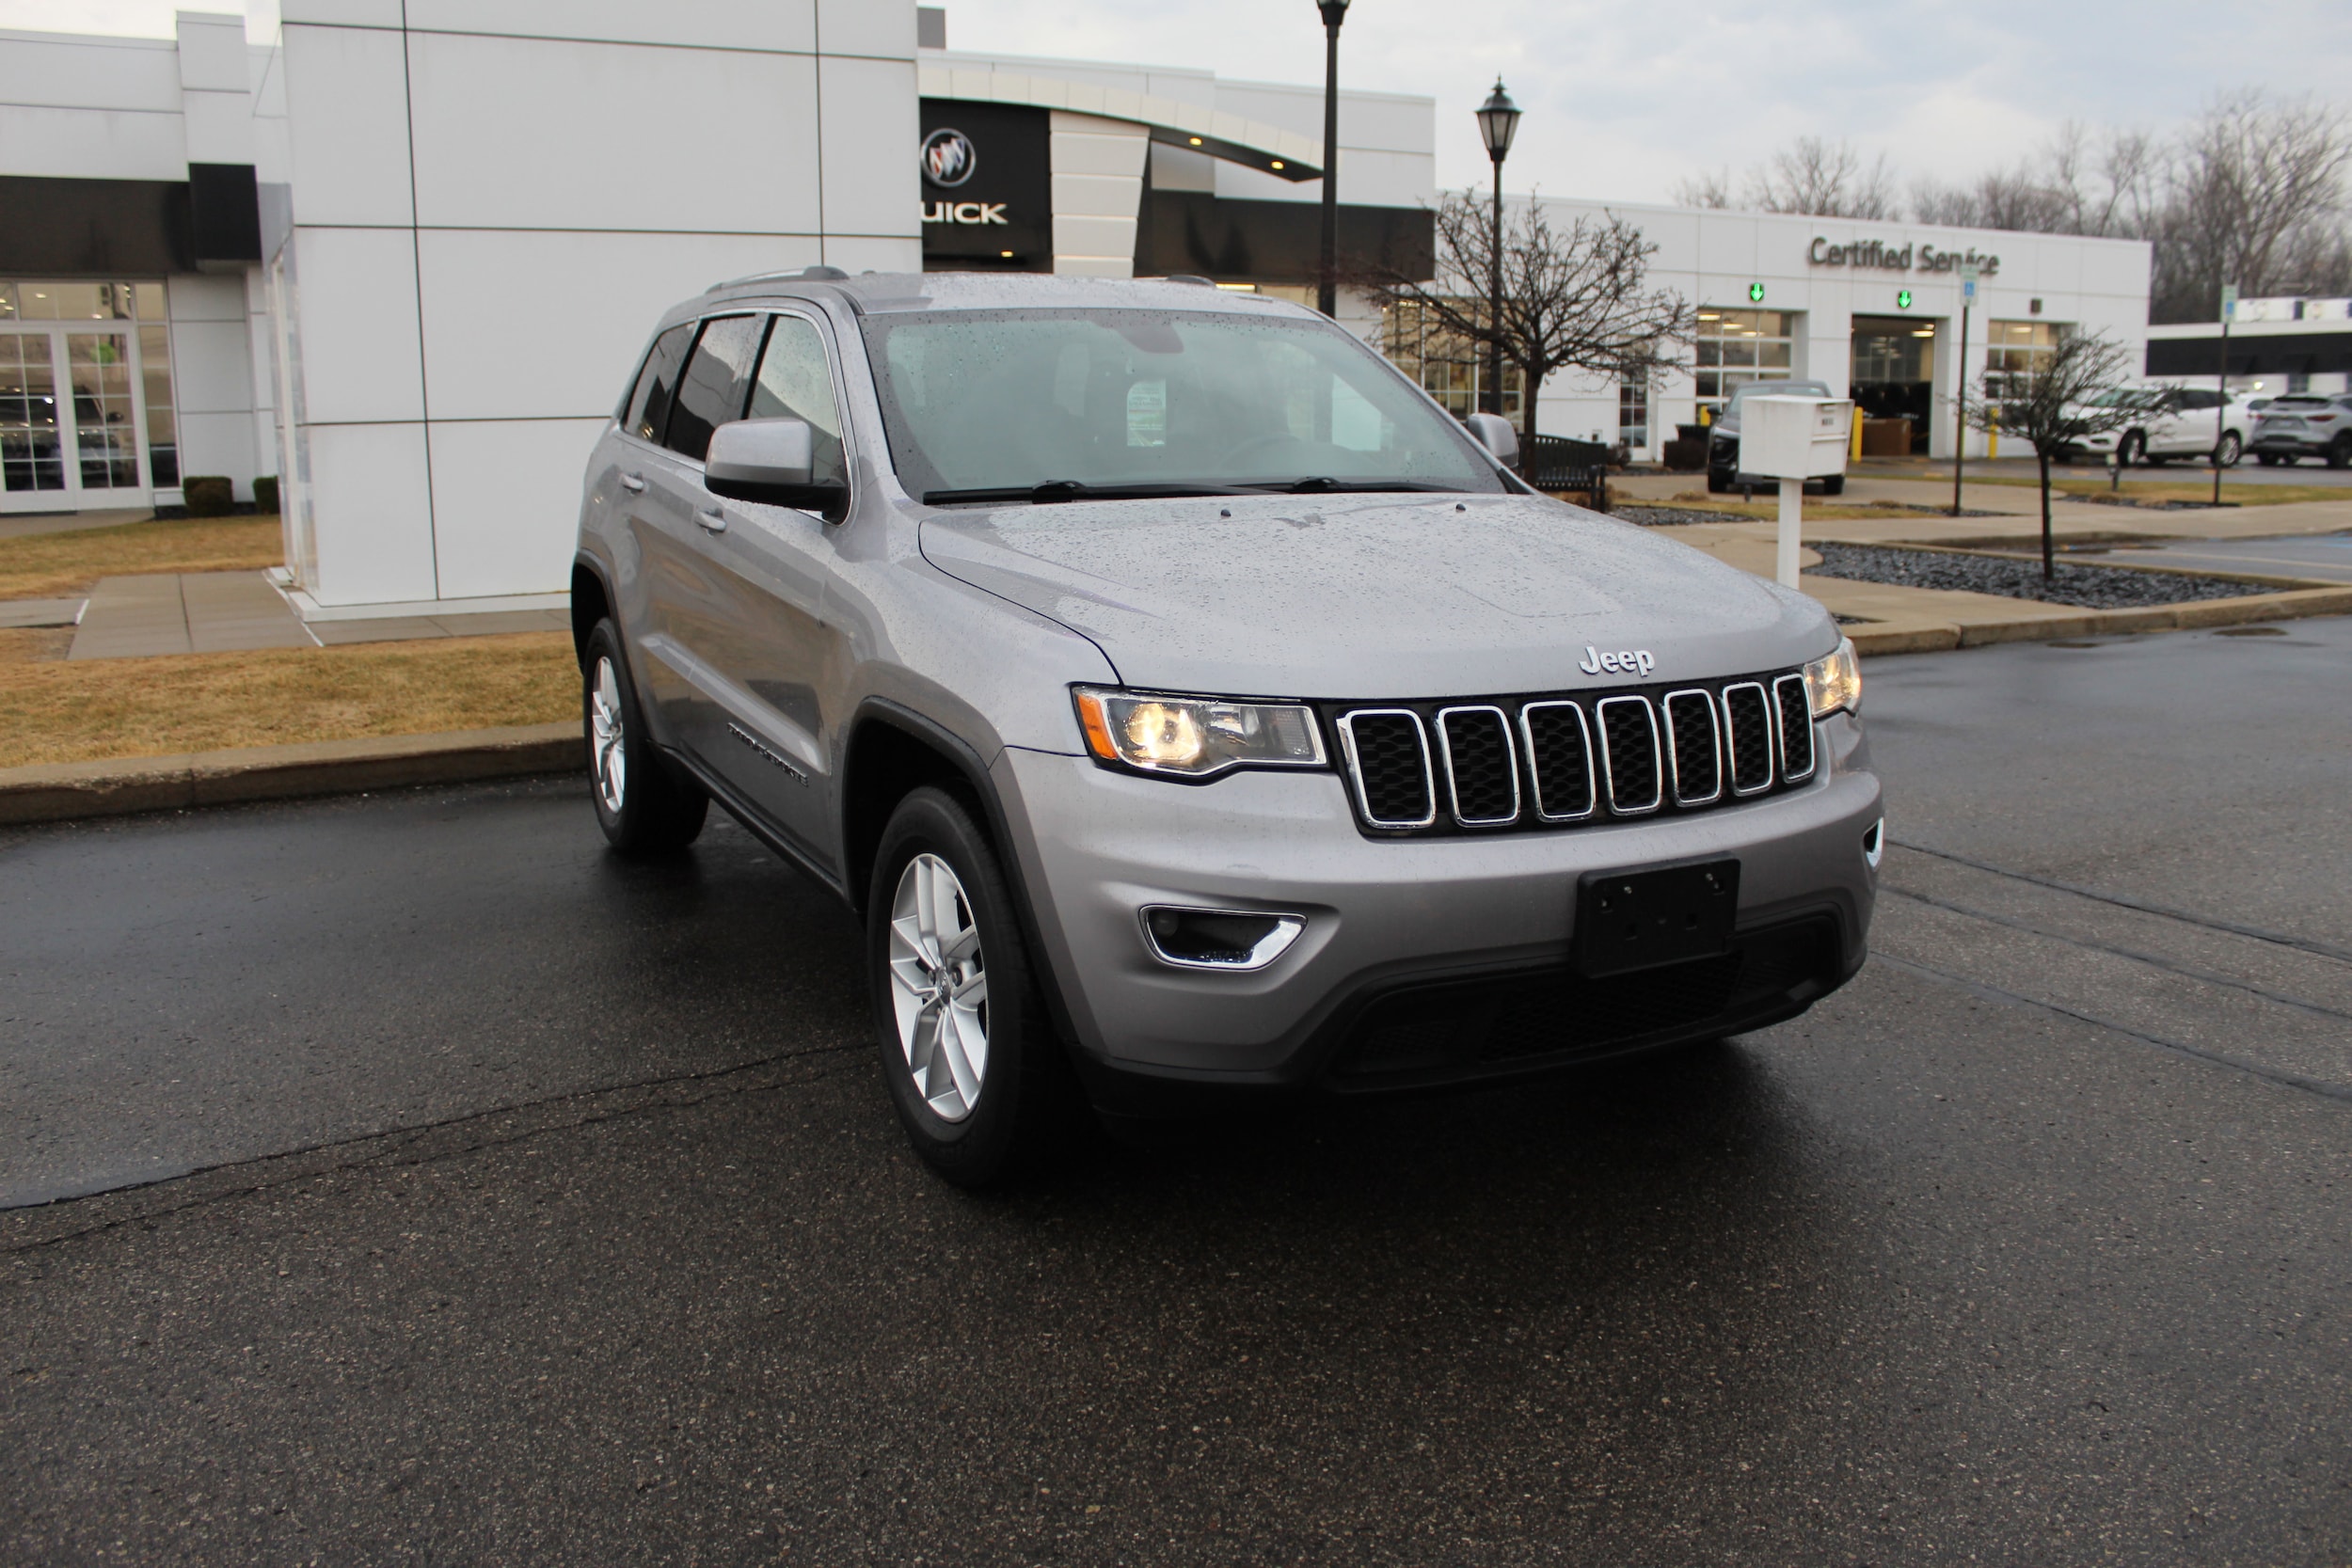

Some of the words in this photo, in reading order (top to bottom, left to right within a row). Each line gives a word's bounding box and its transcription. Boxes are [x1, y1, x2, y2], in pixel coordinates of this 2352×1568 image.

[920, 200, 1009, 225] UICK
[1809, 236, 1914, 271] Certified
[1579, 645, 1655, 677] Jeep
